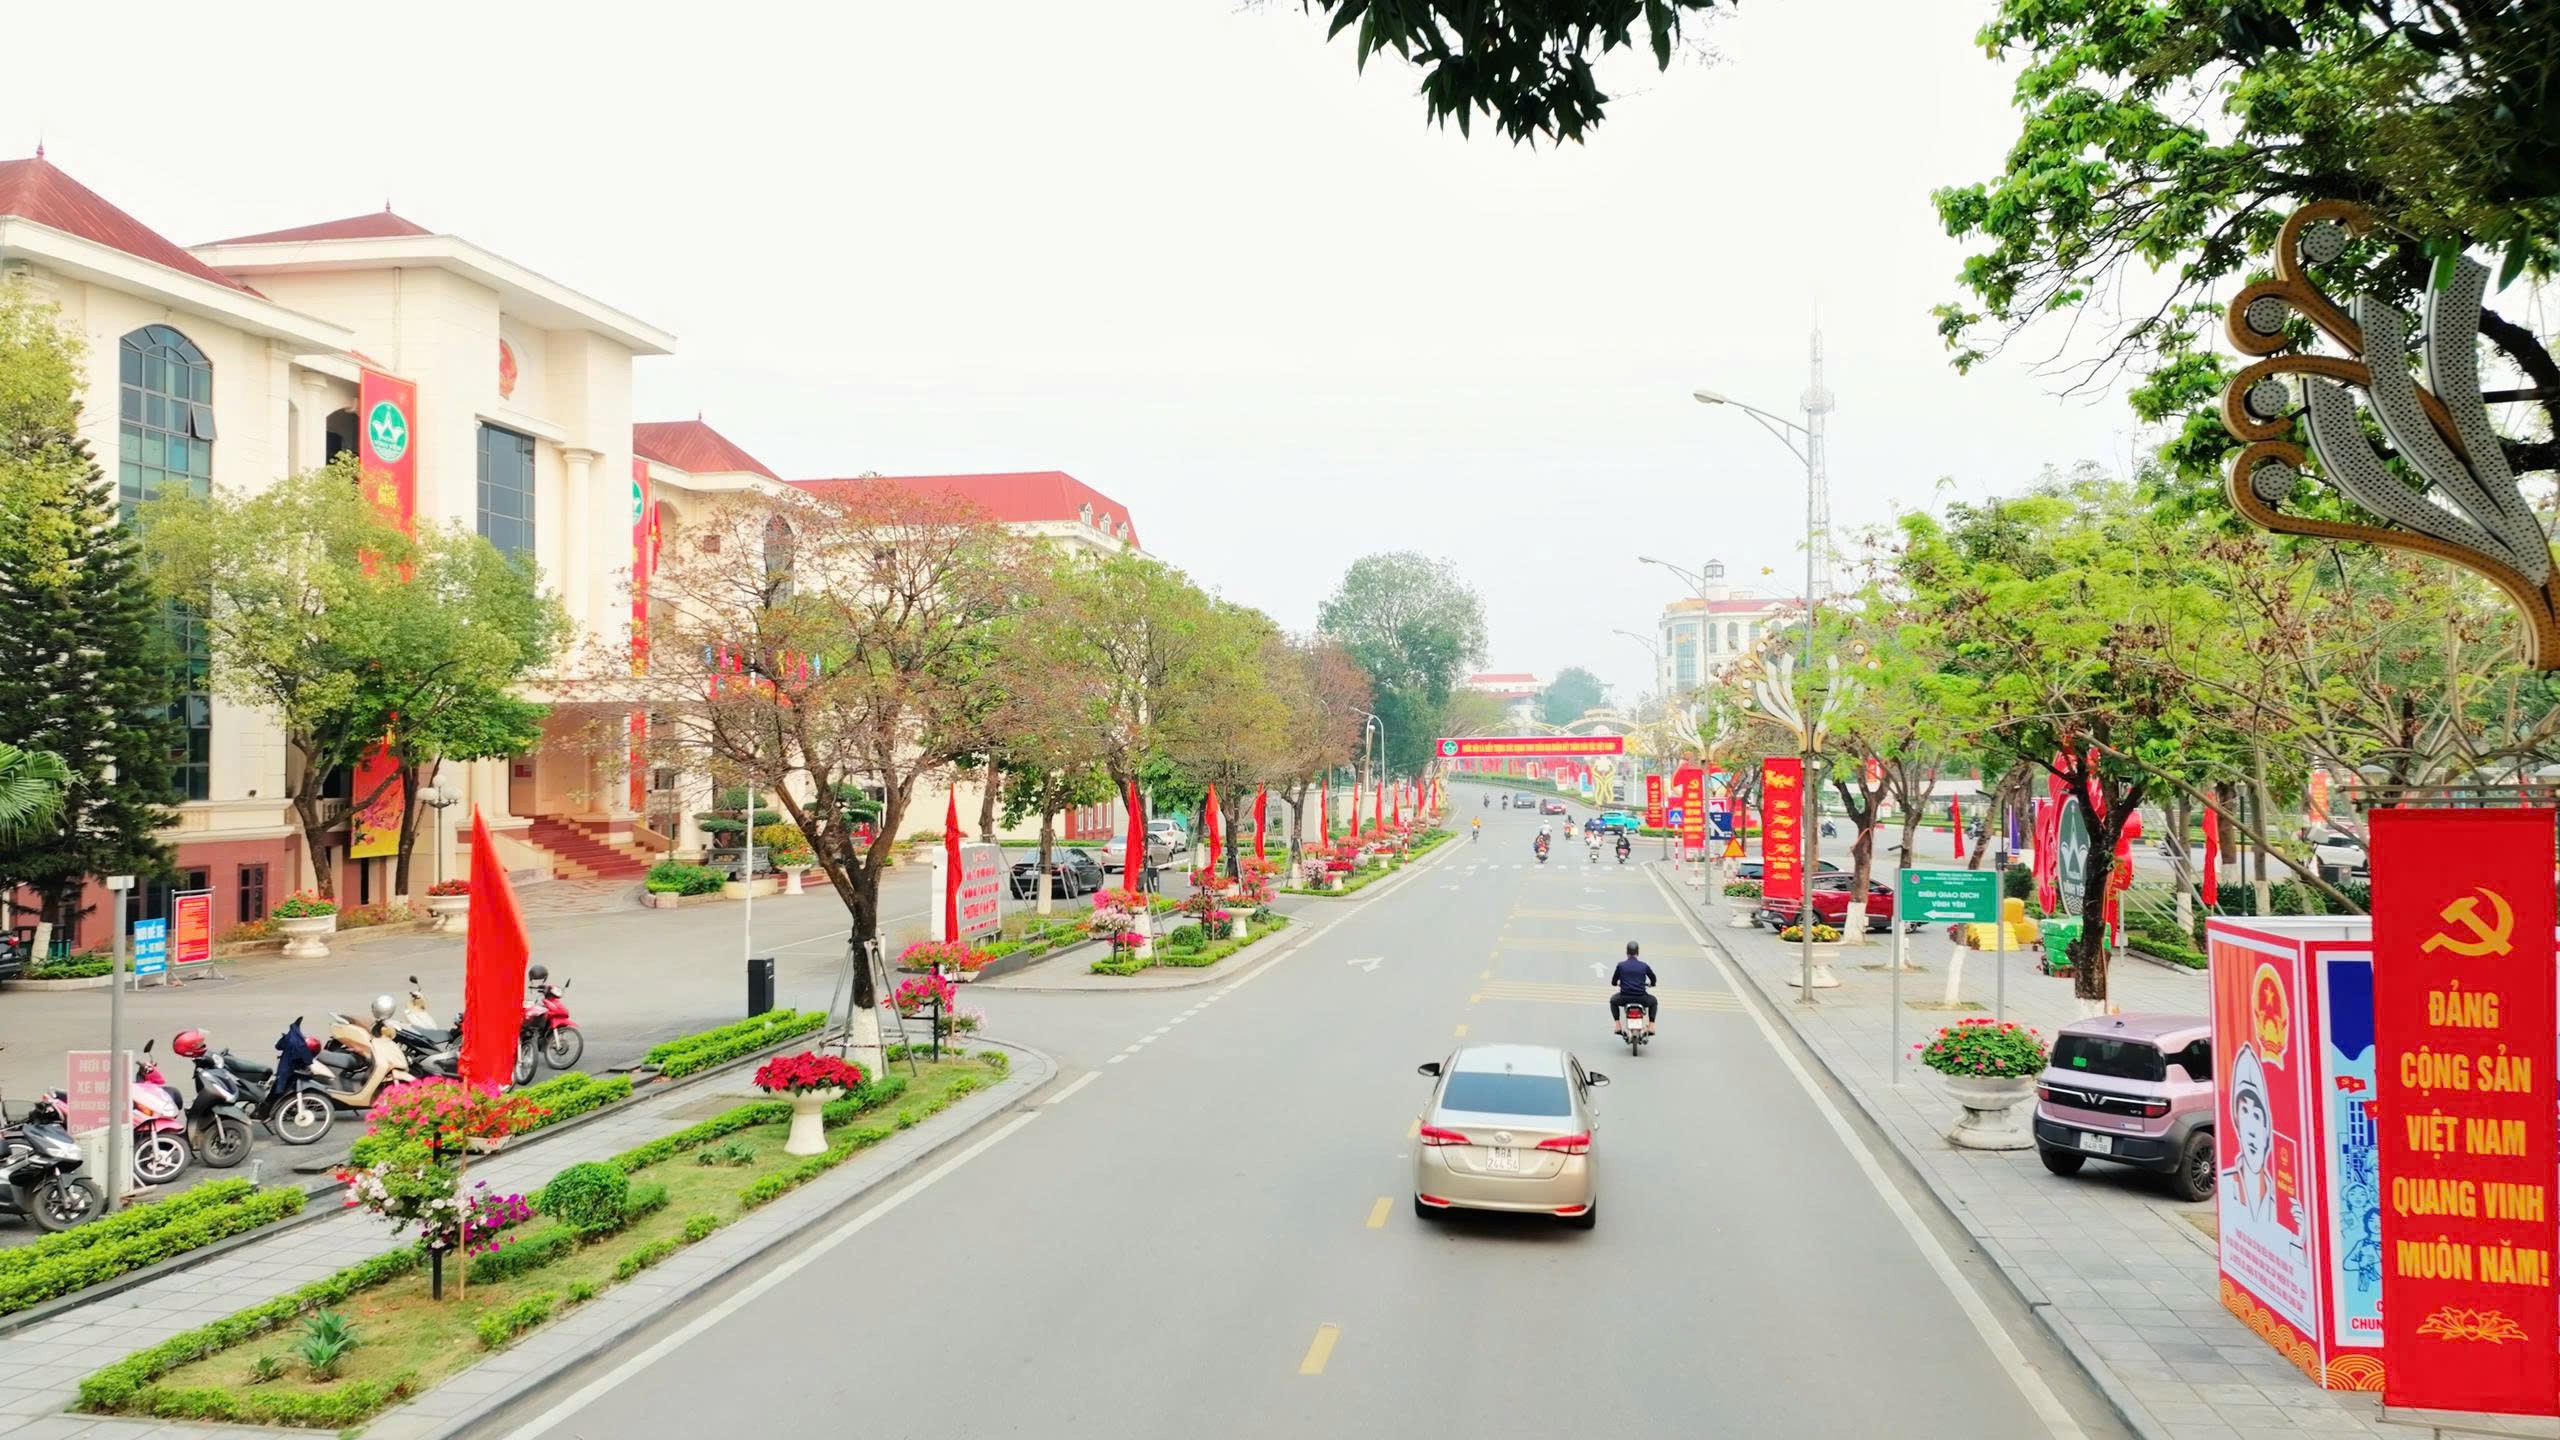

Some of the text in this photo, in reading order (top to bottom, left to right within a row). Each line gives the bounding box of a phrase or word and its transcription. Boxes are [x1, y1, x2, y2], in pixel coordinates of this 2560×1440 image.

[2428, 979, 2499, 1028] ĐẢNG
[2400, 1043, 2532, 1096] CỘNG SẢN
[2406, 1108, 2526, 1160] VIỆT NAM
[2392, 1176, 2544, 1222] QUANG VINH
[2396, 1234, 2549, 1287] MUÔN NĂM!
[2351, 1317, 2383, 1330] CHUN
